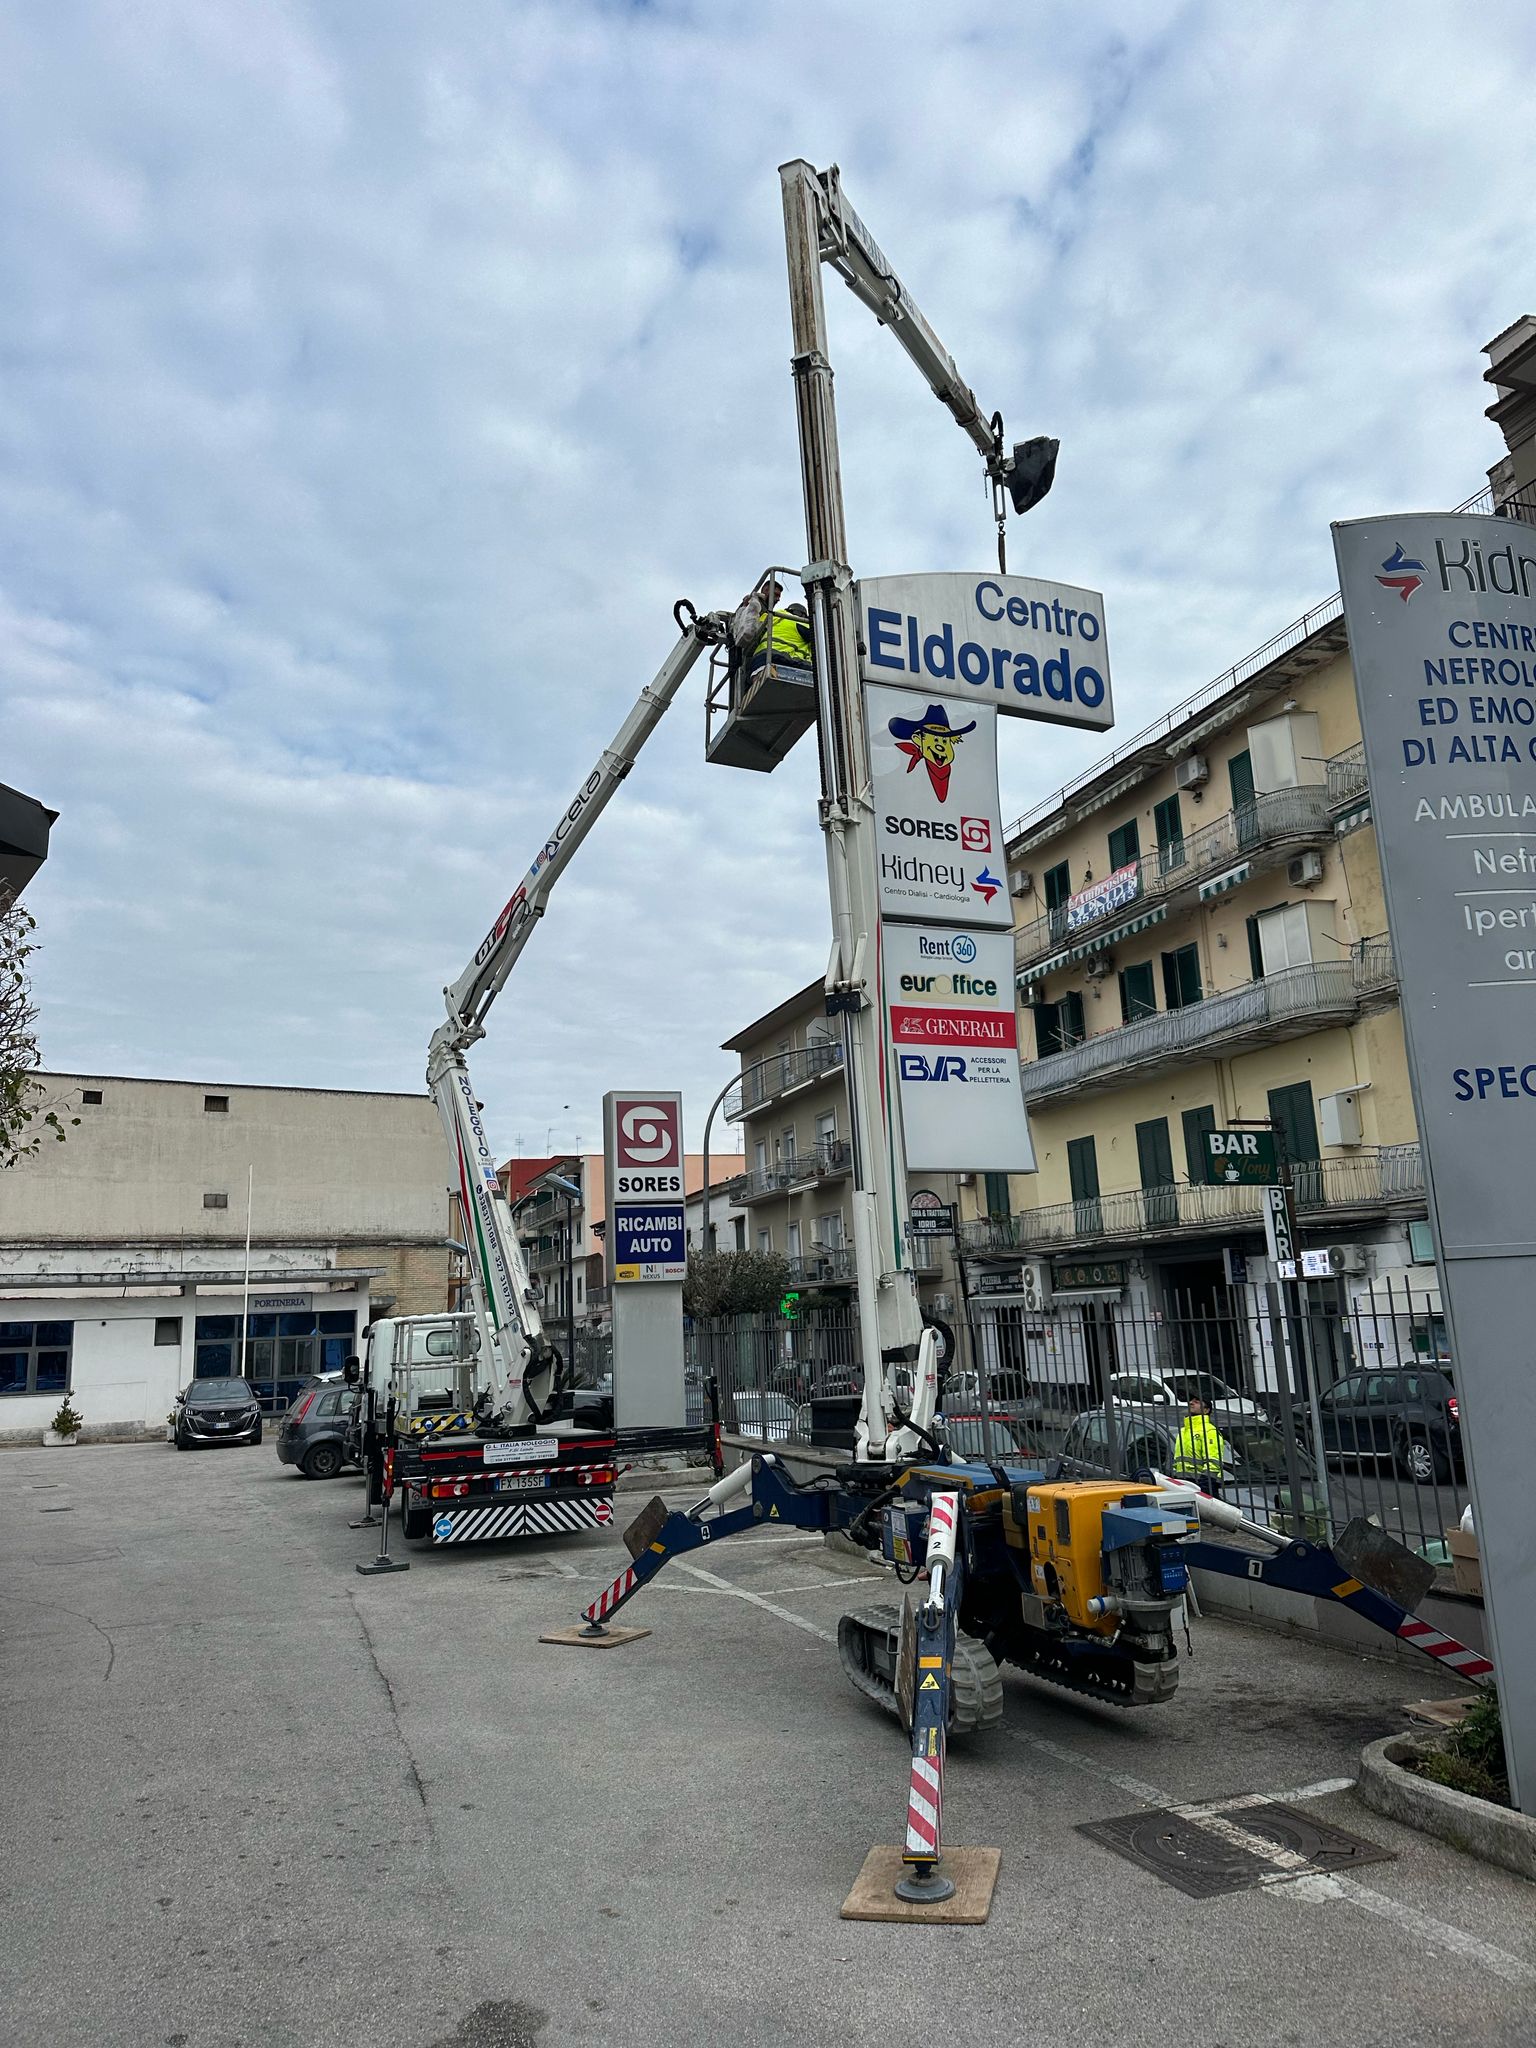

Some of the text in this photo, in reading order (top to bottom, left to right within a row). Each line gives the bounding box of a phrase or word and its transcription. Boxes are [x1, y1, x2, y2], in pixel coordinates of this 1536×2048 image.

[975, 580, 1100, 642] Centro
[1449, 620, 1536, 653] CENTR
[867, 607, 1105, 708] Eldorado
[1424, 658, 1536, 688] NEFROL
[1418, 696, 1536, 726] ED EMO
[1403, 737, 1436, 767] DI
[1449, 734, 1522, 763] ALTA
[885, 815, 959, 842] SORES
[881, 853, 965, 893] Kidney
[884, 886, 907, 896] Centro
[908, 889, 928, 898] Dialisi
[933, 891, 971, 903] Cardiologia
[919, 936, 972, 957] Rent 360
[925, 1018, 1006, 1039] GENERALI
[900, 1054, 969, 1082] BVR
[969, 1076, 1011, 1084] PELLETTERIA
[458, 1076, 489, 1157] NOLEGGIO
[1209, 1134, 1260, 1155] BAR
[1238, 1156, 1272, 1182] Tony
[618, 1176, 681, 1193] SORES
[618, 1216, 683, 1232] RICAMBI
[1270, 1189, 1292, 1260] BAR
[629, 1238, 672, 1253] AUTO
[254, 1298, 306, 1308] PORTINERIA
[521, 1439, 556, 1447] NOLEGGIO
[500, 1478, 512, 1490] FX
[932, 1541, 941, 1549] 2
